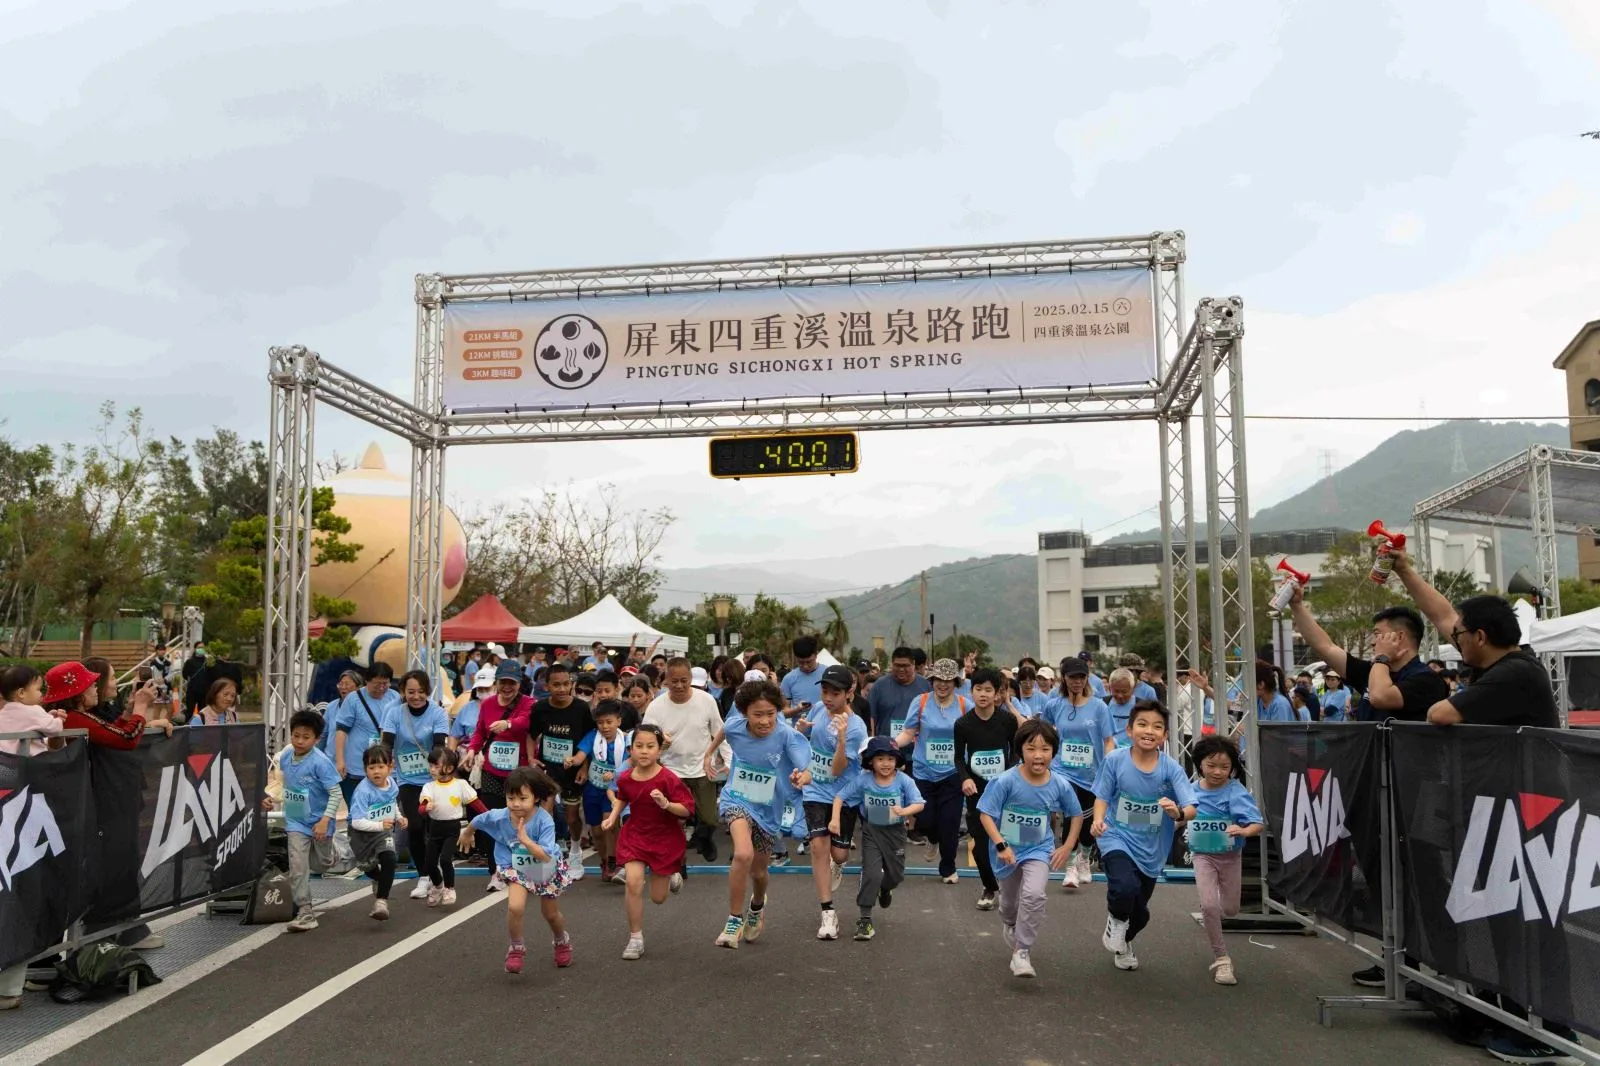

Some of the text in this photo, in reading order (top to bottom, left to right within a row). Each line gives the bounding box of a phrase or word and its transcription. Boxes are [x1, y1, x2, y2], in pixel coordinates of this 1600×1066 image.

[1034, 304, 1109, 317] 2025.02.15
[624, 303, 1010, 358] 屏東四重溪溫泉路跑
[1034, 322, 1130, 339] 四重溪溫泉公園
[468, 333, 491, 341] 21KM
[468, 351, 491, 360] 12KM
[626, 352, 963, 379] PINGTUNG SICHONGXI HOT SPRING
[471, 369, 489, 378] 3KM
[493, 746, 516, 755] 3087
[546, 741, 569, 751] 3329
[930, 743, 953, 751] 3002
[1065, 744, 1090, 754] 3256
[975, 756, 1001, 766] 3363
[738, 770, 771, 784] 3107
[868, 797, 896, 807] 3003
[1123, 801, 1159, 814] 3258
[370, 805, 392, 819] 3170
[1281, 767, 1351, 864] LAVA
[1007, 813, 1042, 827] 3259
[1192, 821, 1227, 832] 3260
[213, 808, 254, 871] SPORTS
